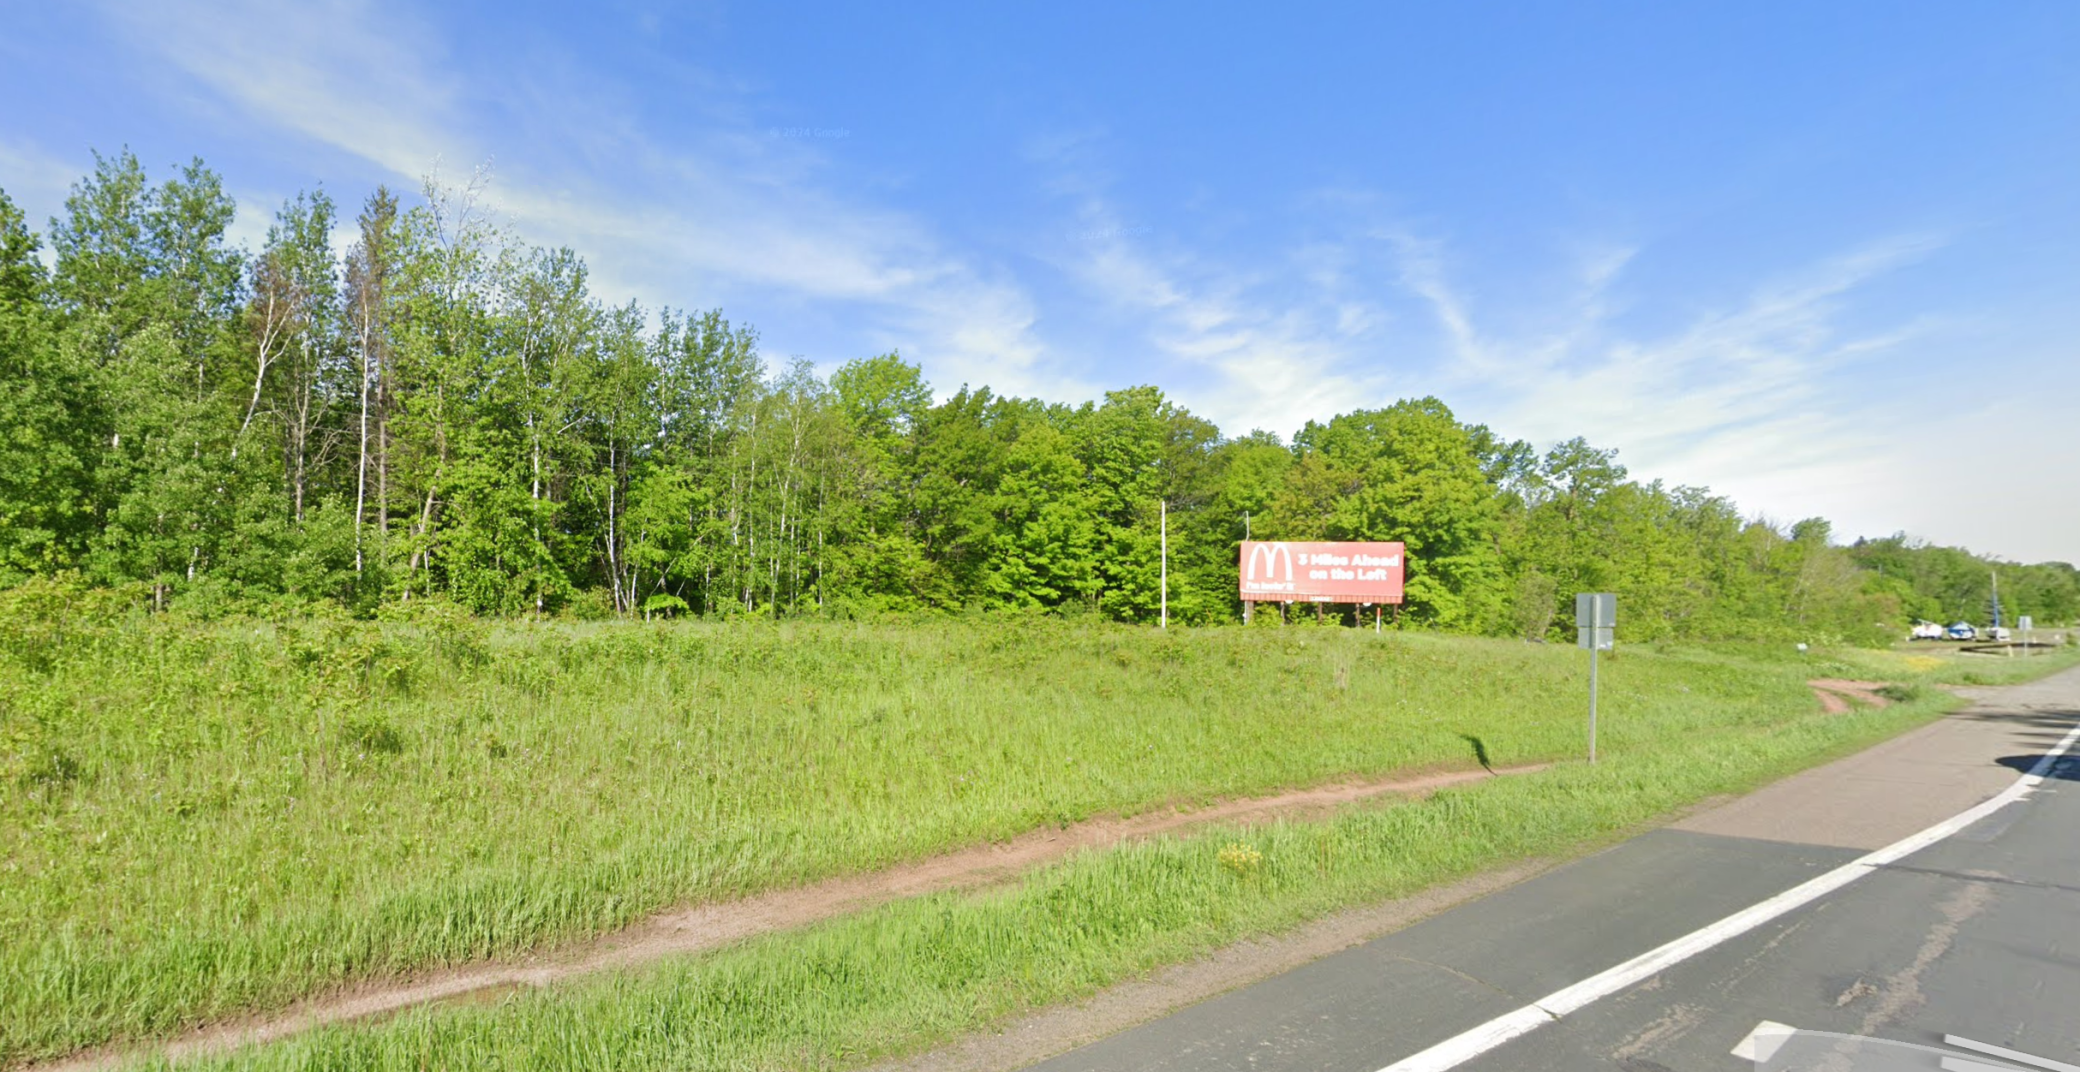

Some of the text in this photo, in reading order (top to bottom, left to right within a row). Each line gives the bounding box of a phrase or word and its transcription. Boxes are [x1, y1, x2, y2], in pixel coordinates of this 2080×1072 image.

[1297, 553, 1399, 567] 3 Miles Ahead
[1309, 568, 1387, 580] on the Left
